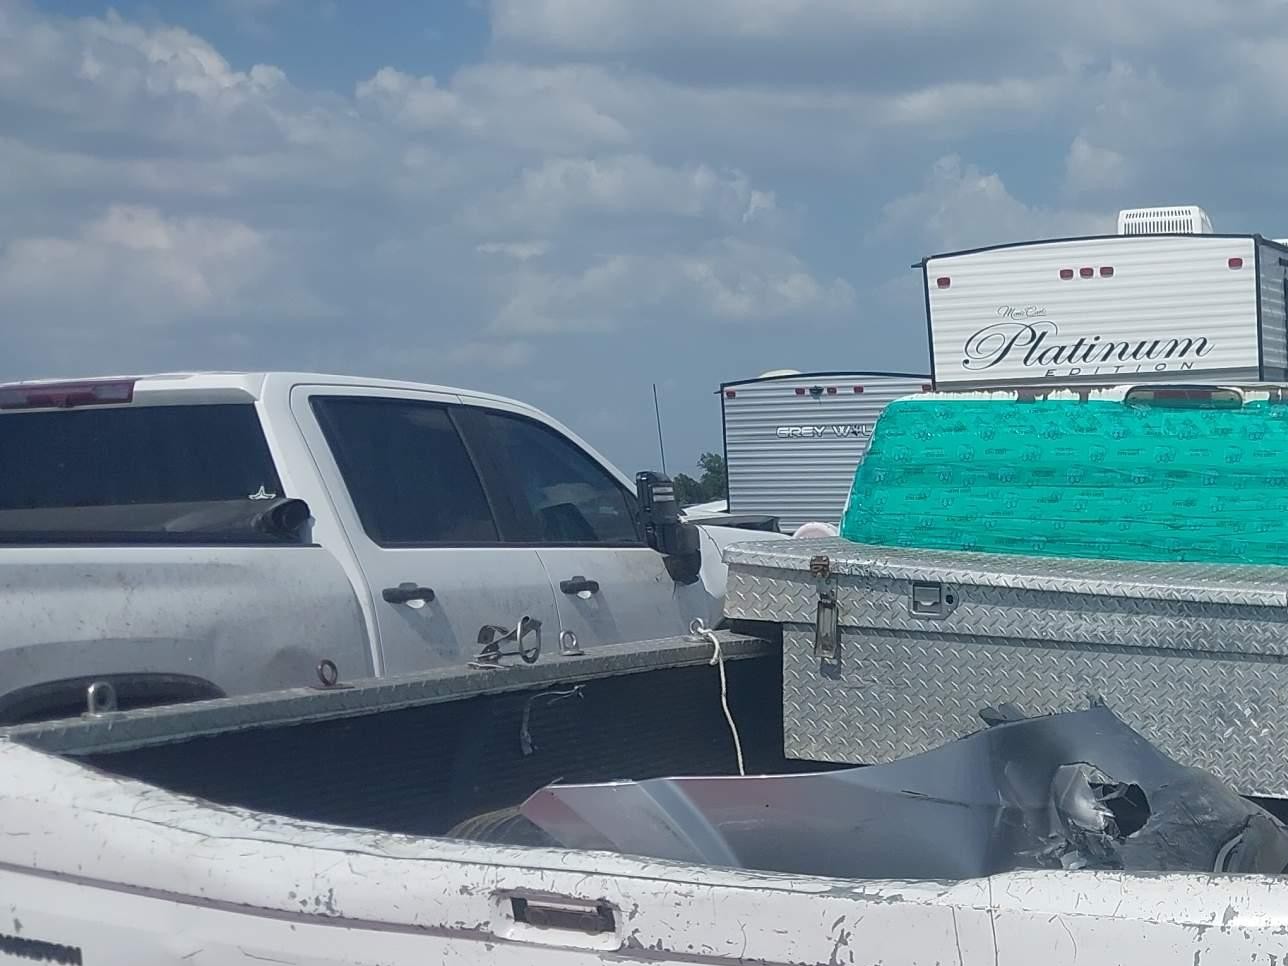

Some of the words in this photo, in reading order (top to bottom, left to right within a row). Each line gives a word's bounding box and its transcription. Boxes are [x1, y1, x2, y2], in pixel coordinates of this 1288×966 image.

[962, 320, 1215, 371] Platinum
[1044, 361, 1195, 378] EDITION
[776, 425, 826, 438] GREY
